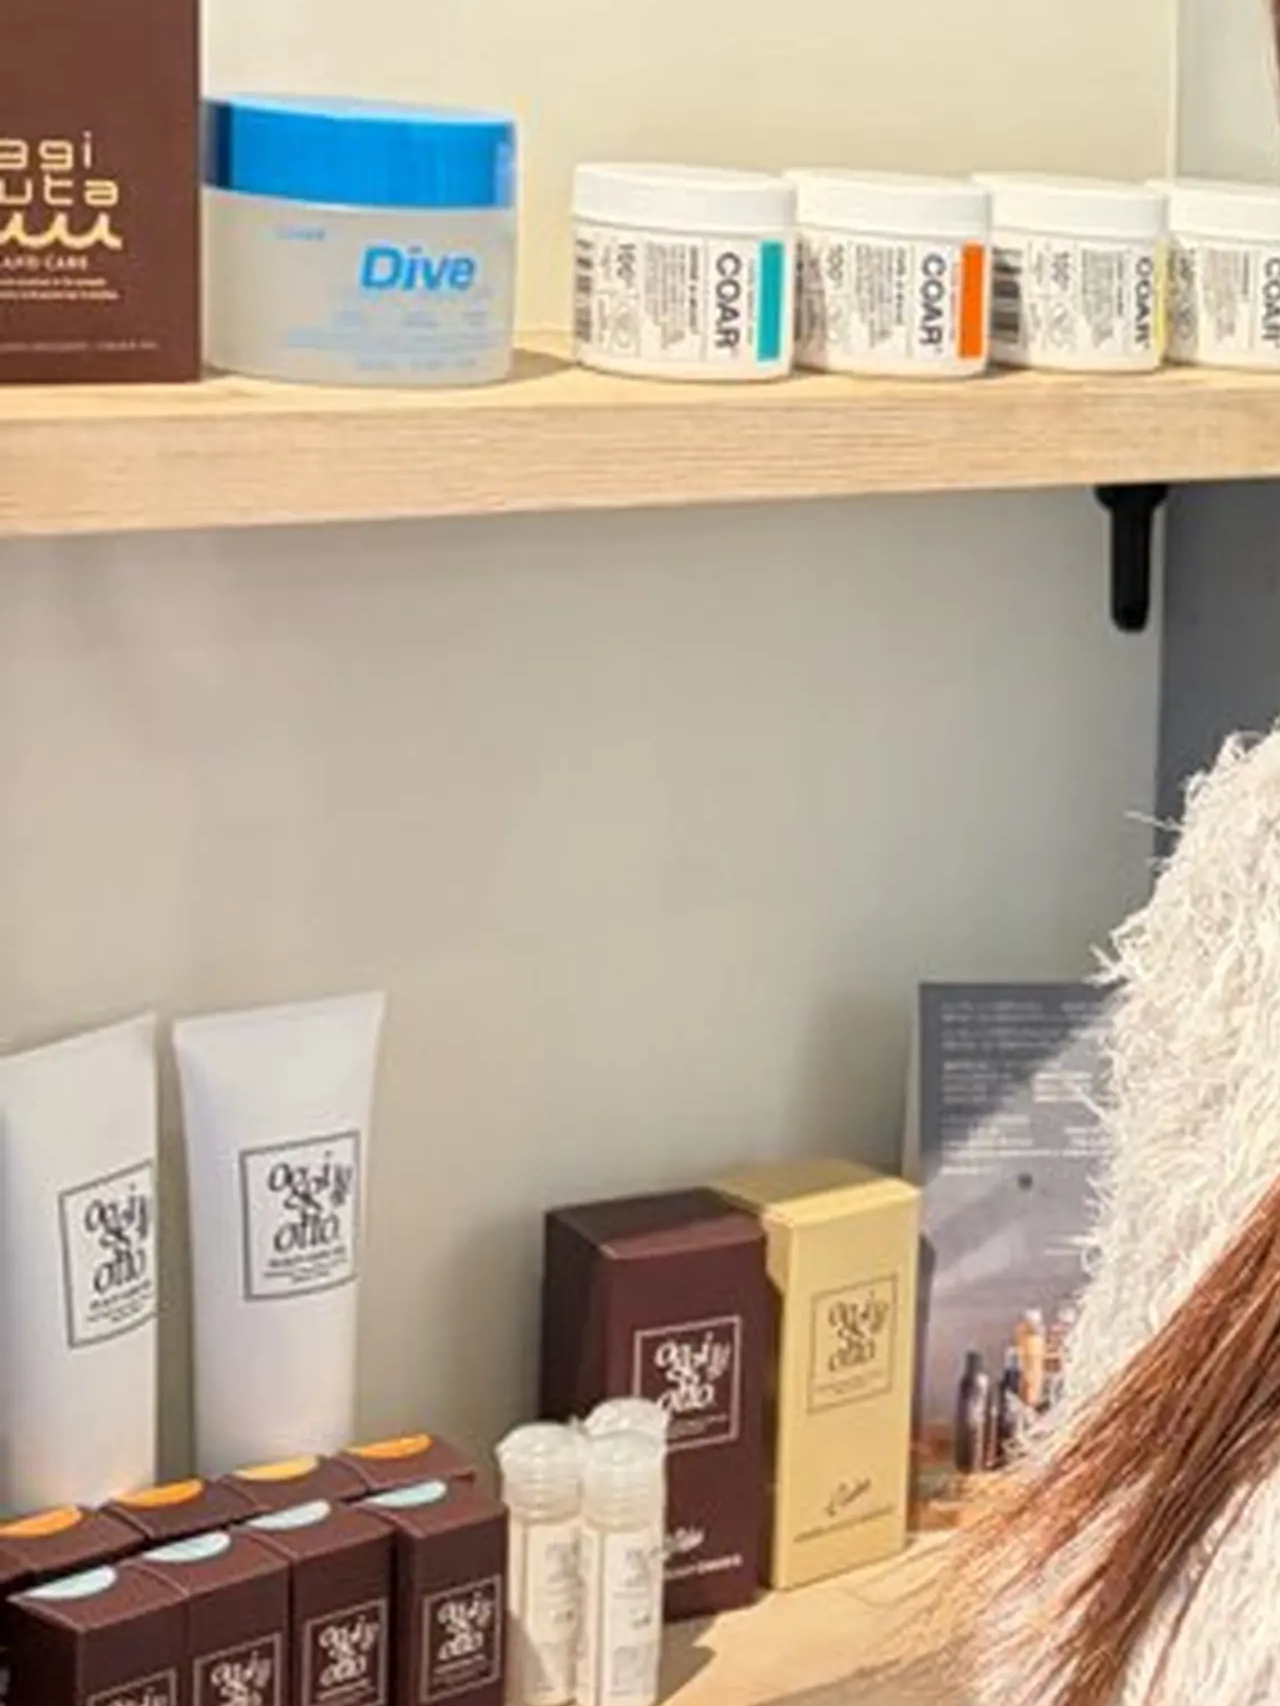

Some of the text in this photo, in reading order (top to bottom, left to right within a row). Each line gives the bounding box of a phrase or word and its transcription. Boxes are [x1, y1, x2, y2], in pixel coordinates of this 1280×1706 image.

[360, 244, 476, 291] Dive
[714, 252, 743, 349] COAR
[919, 253, 946, 346] COAR
